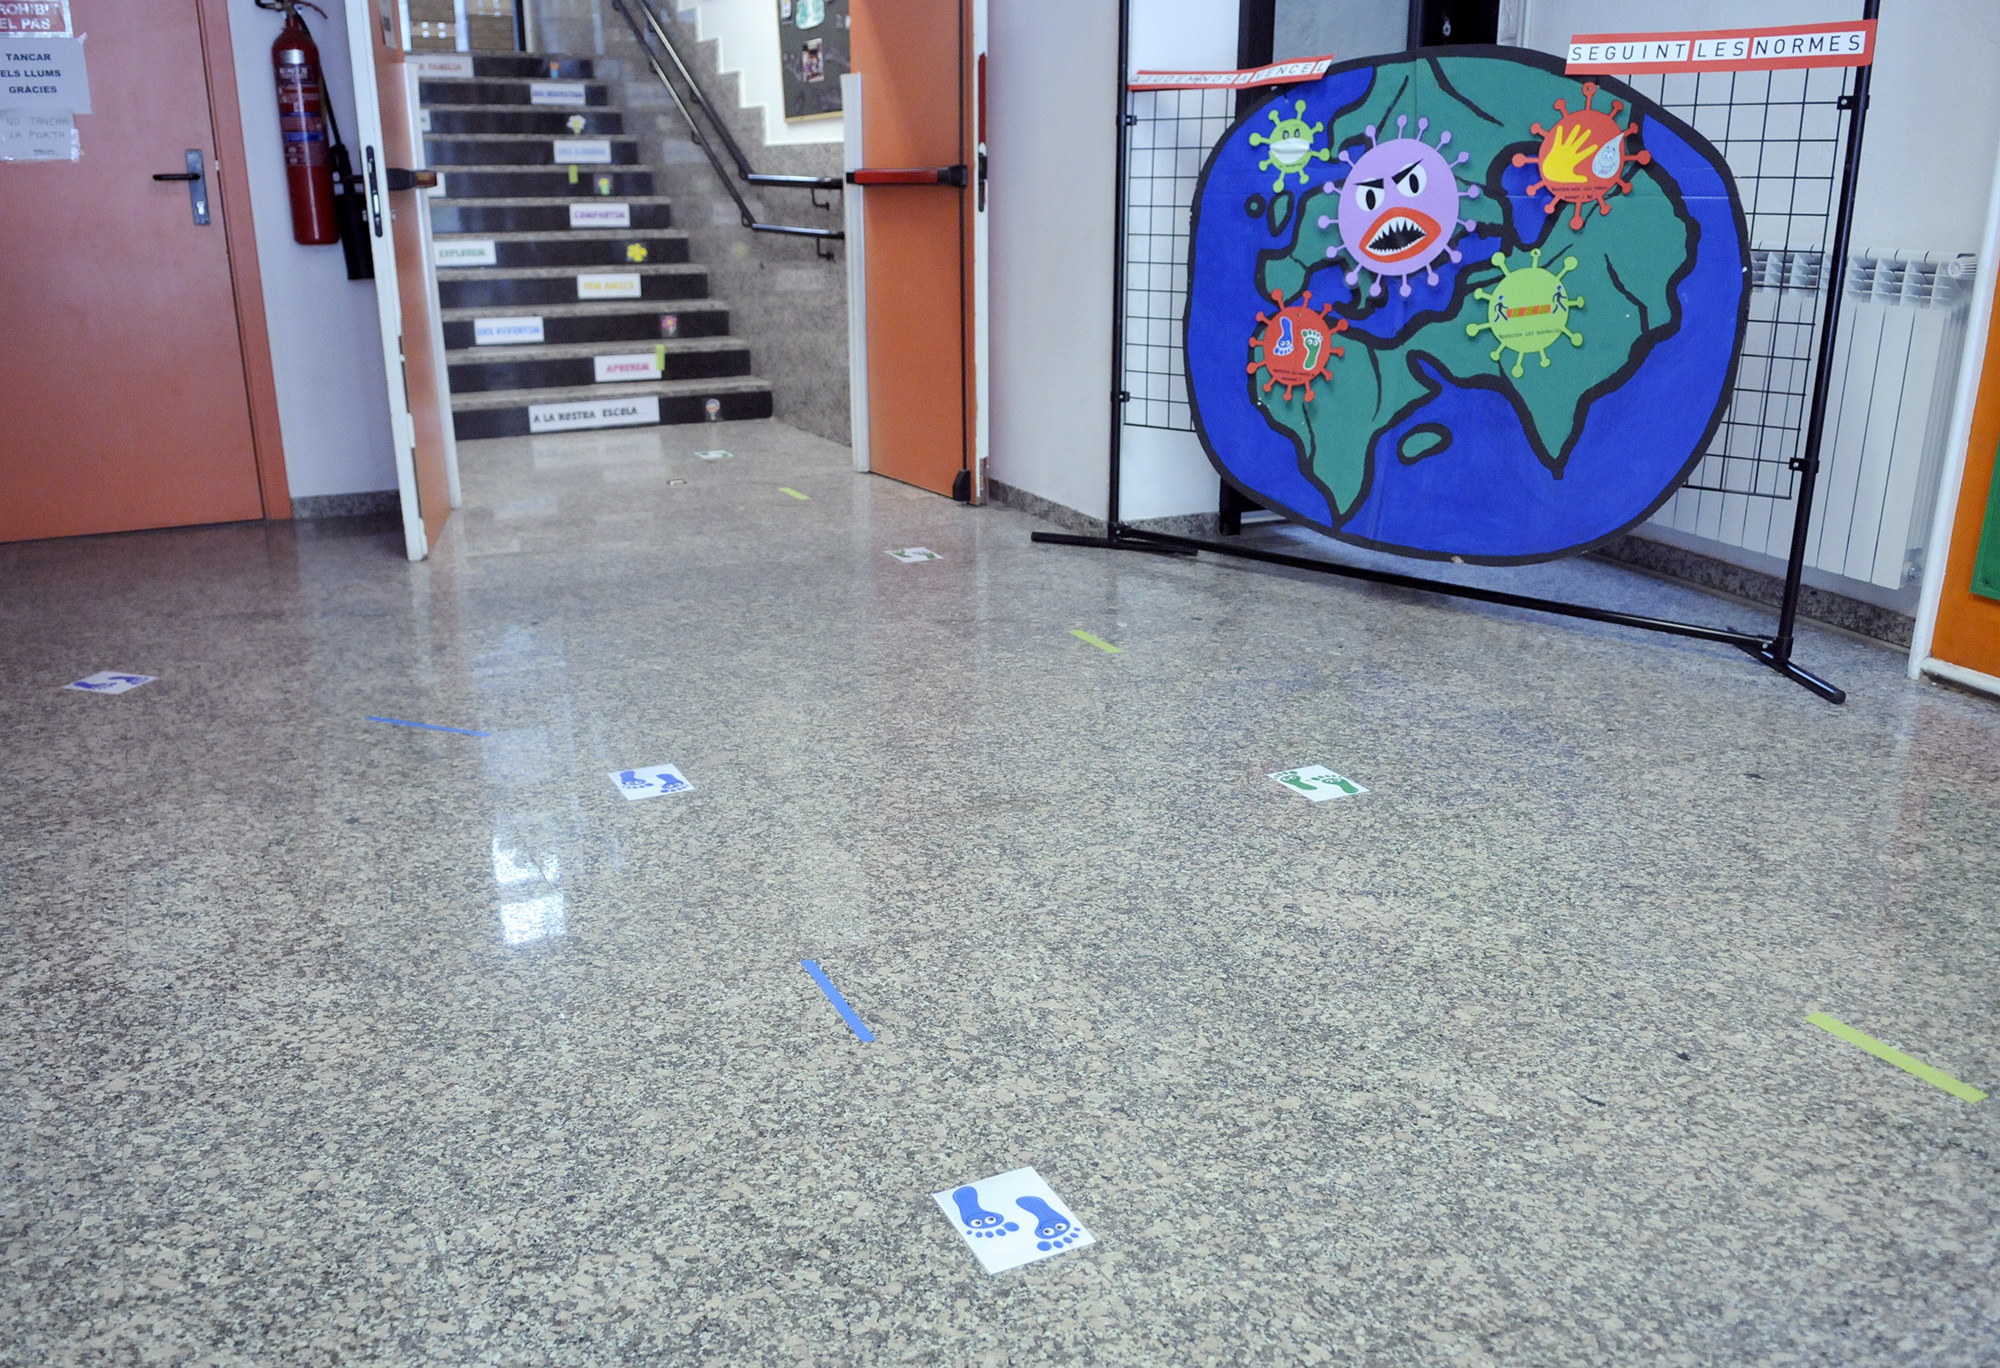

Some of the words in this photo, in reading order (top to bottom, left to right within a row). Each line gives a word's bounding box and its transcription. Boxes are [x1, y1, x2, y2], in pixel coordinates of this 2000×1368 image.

[0, 3, 59, 15] ROHIBIT
[20, 17, 51, 30] PAS
[1571, 43, 1686, 61] SEGUINT
[1697, 40, 1744, 58] LES
[1754, 34, 1861, 56] NORMES
[5, 53, 51, 61] TANCAR
[0, 69, 21, 77] ELS
[24, 69, 61, 77] LLUMS
[543, 413, 555, 422] LA
[558, 410, 596, 421] NOSTRA
